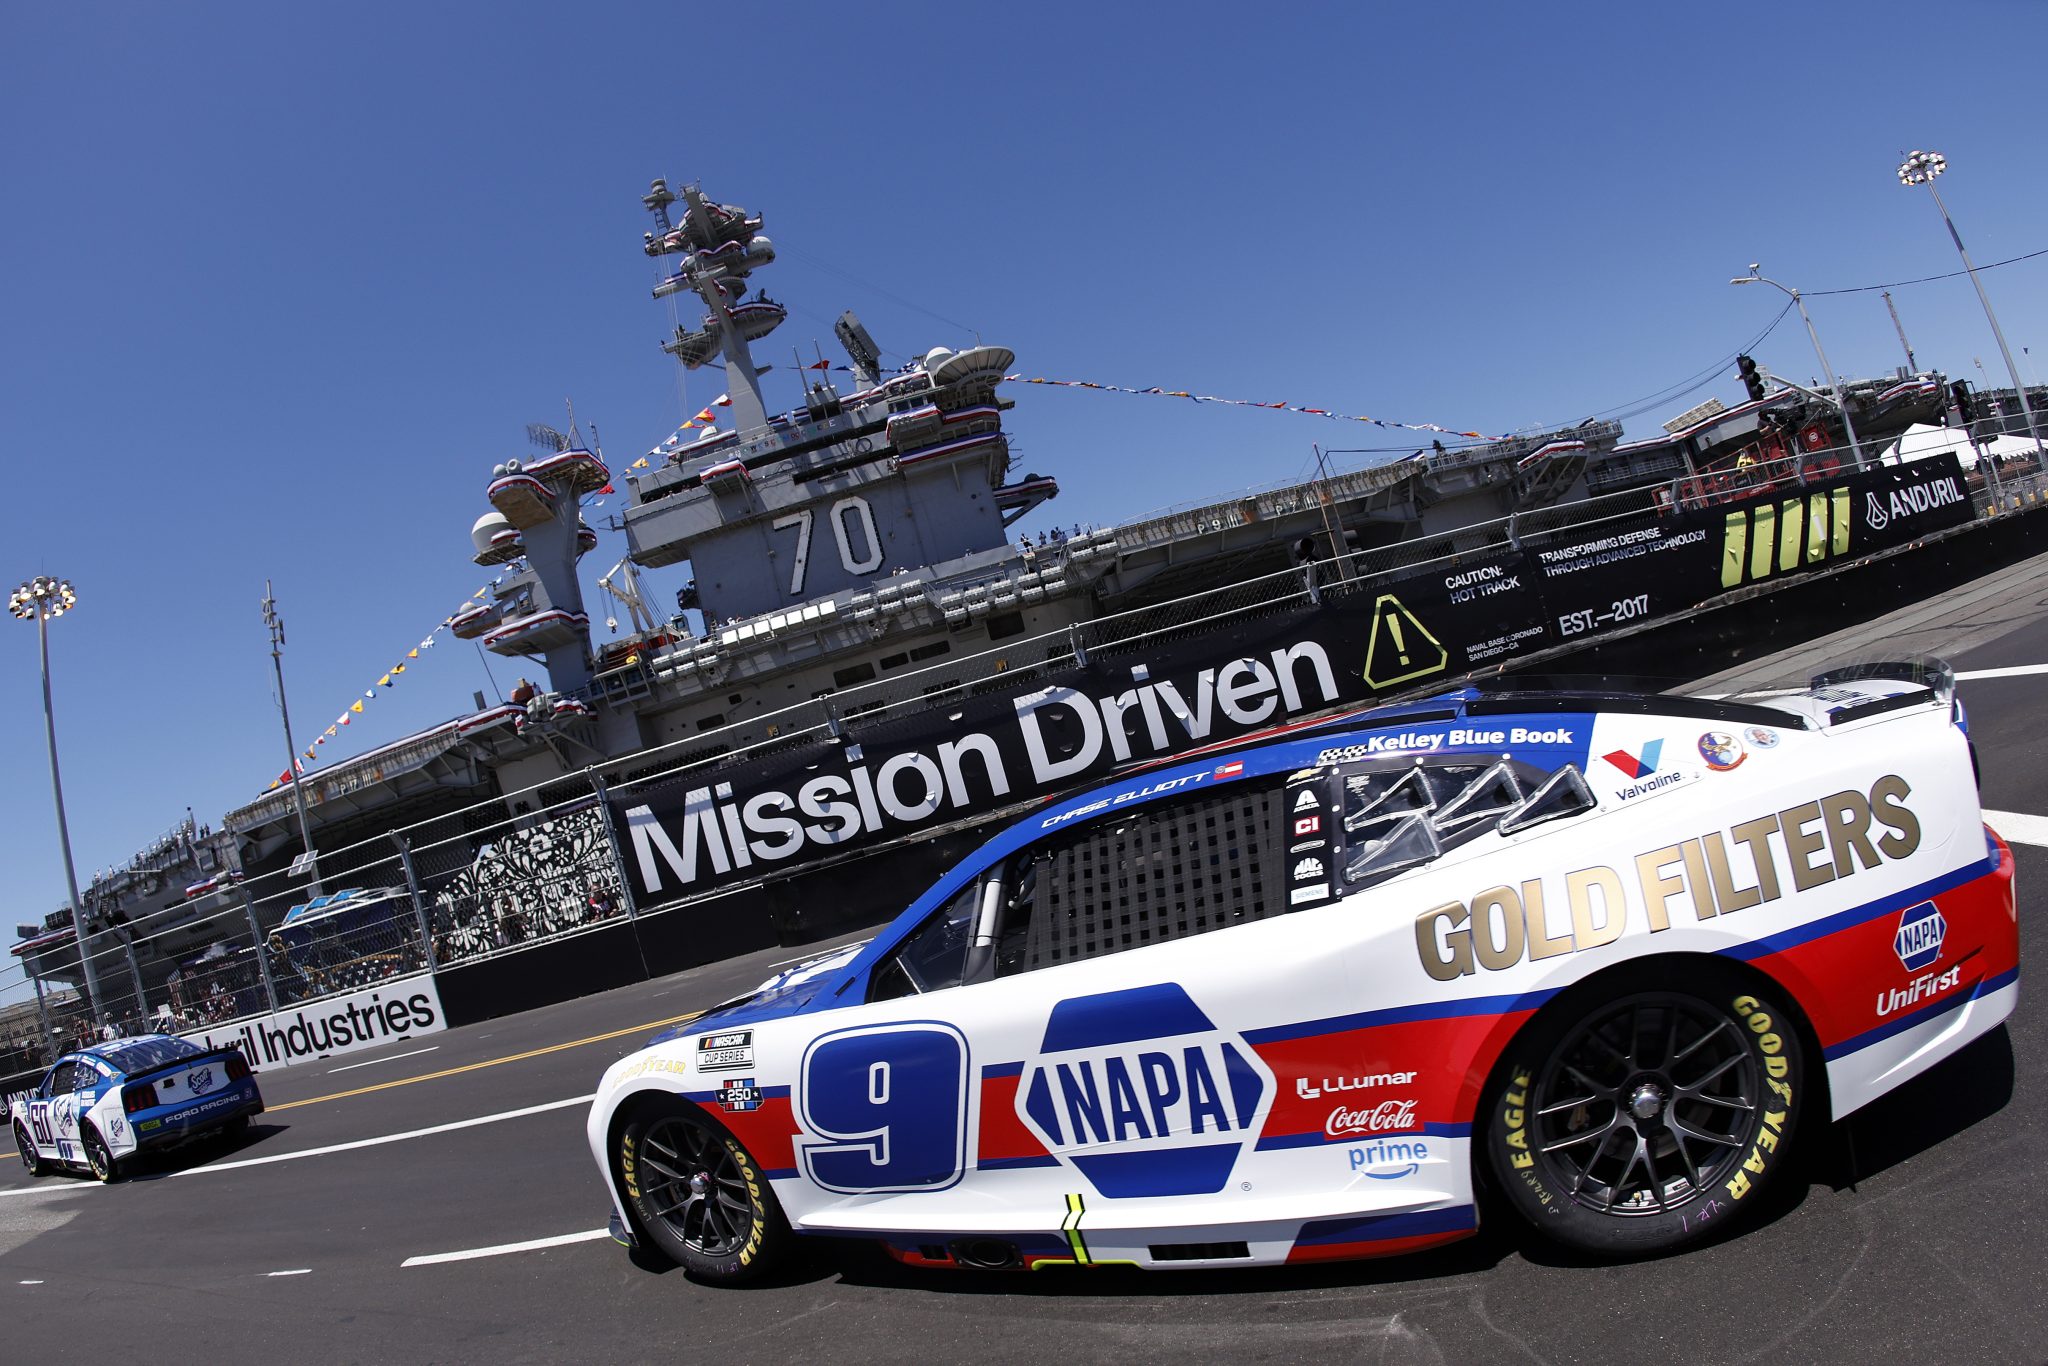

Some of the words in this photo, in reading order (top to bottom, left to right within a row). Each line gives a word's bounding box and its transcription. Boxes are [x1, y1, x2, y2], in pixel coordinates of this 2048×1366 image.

[1889, 477, 1965, 520] ANDURIL
[773, 495, 885, 596] 70
[1538, 537, 1619, 564] TRANSFORMING
[1617, 527, 1662, 546] DEFENSE
[1543, 556, 1595, 578] THROUGH
[1595, 545, 1647, 567] ADVANCED
[1646, 529, 1707, 553] TECHNOLOGY
[1445, 565, 1504, 589] CAUTION:
[1450, 587, 1476, 605] HOT
[1477, 575, 1521, 597] TRACK
[1466, 641, 1489, 654] NAVAL
[1487, 636, 1505, 649] BASE
[1505, 626, 1544, 642] CORONADO
[1468, 650, 1484, 662] SAN
[1367, 734, 1446, 752] Kelley
[1449, 728, 1505, 746] Blue
[1510, 728, 1574, 744] Book
[625, 733, 1010, 893] Mission
[1013, 640, 1340, 784] Driven
[1615, 772, 1682, 801] Valvoline
[1041, 798, 1112, 829] CHASE
[1112, 771, 1211, 805] ELLIOTT
[1295, 817, 1319, 835] CI
[1415, 865, 1629, 982] GOLD
[1634, 774, 1922, 934] FILTERS
[1904, 918, 1940, 956] NAPA
[1876, 965, 1960, 1016] UniFirst
[257, 993, 436, 1063] Industries
[714, 1034, 746, 1048] NASCAR
[704, 1053, 719, 1064] CUP
[719, 1050, 745, 1062] SERIES
[165, 1107, 200, 1124] FORD
[201, 1093, 240, 1112] RACING
[727, 1087, 751, 1101] 250
[801, 1019, 971, 1194] 9
[1056, 1046, 1230, 1144] NAPA
[1725, 995, 1793, 1201] GOODYEAR
[30, 1103, 56, 1147] 60
[1503, 1063, 1535, 1170] EAGLE
[623, 1134, 641, 1198] EAGLE
[1348, 1140, 1428, 1171] prime
[725, 1138, 765, 1266] GOODYEAR
